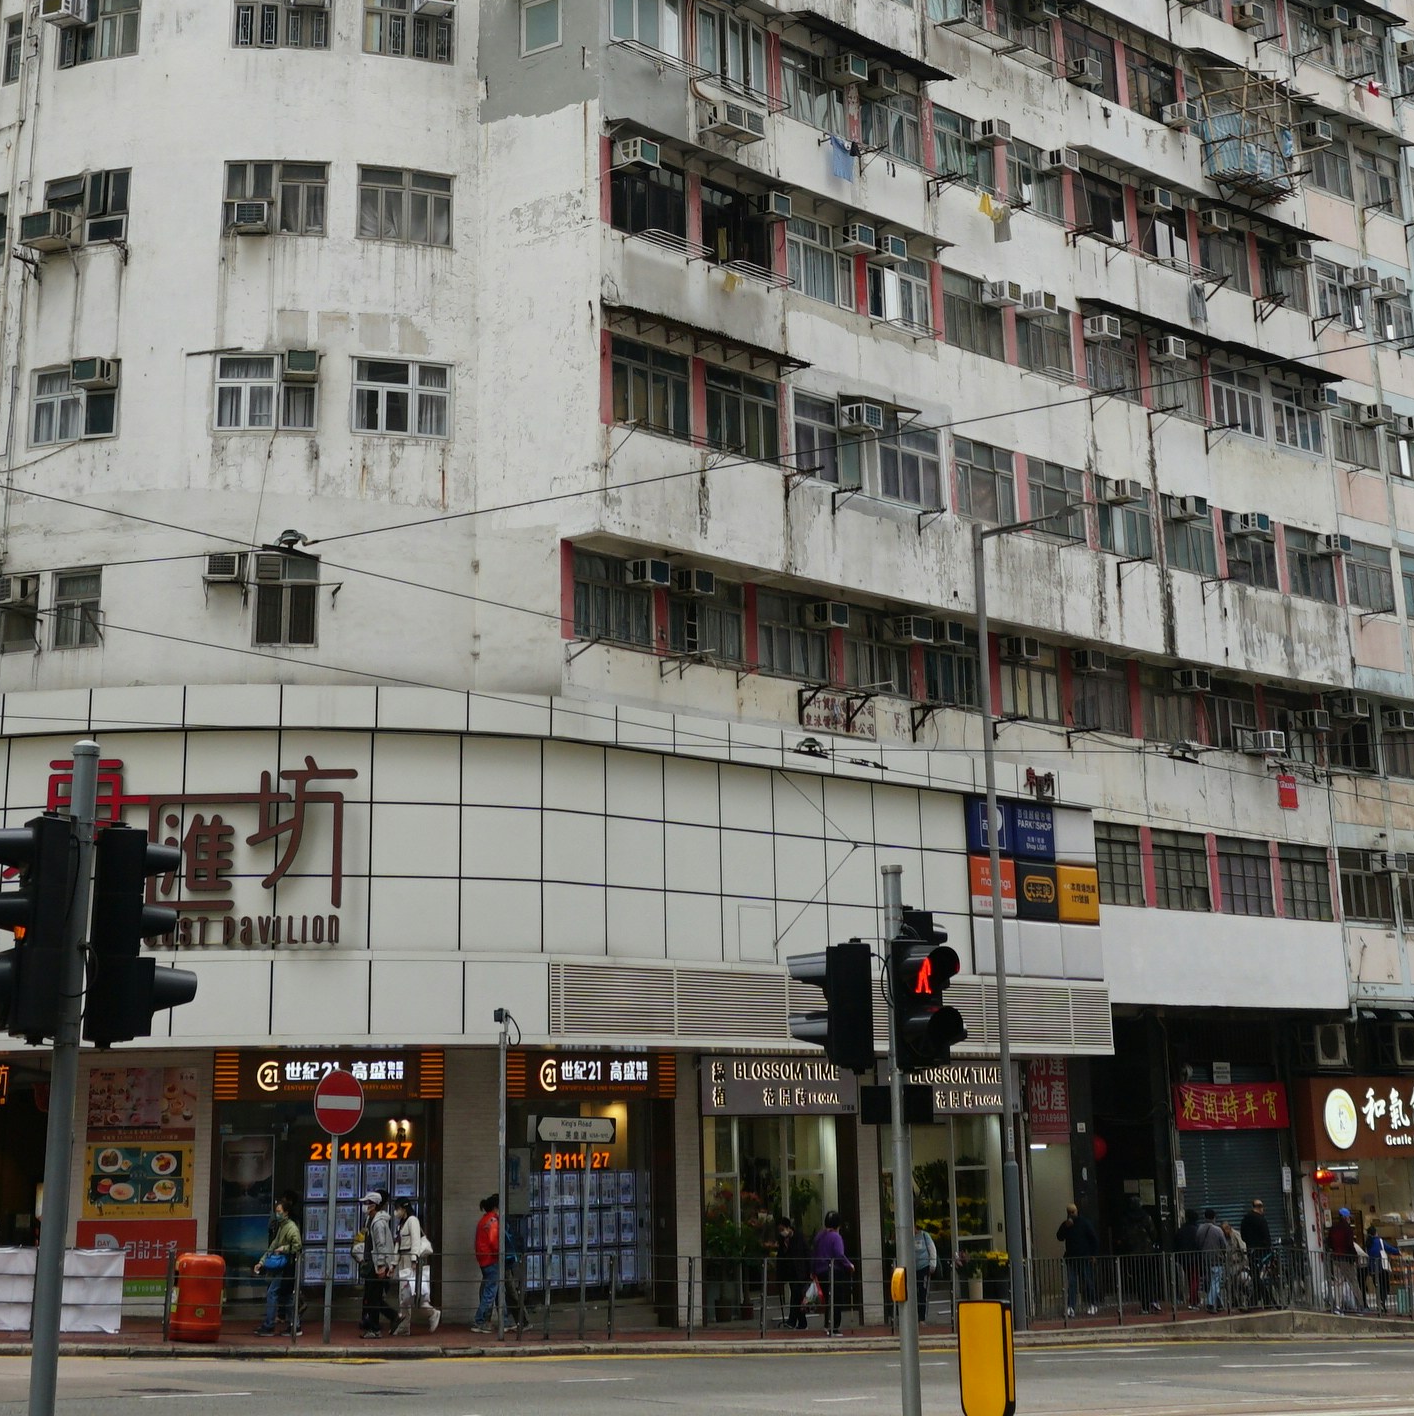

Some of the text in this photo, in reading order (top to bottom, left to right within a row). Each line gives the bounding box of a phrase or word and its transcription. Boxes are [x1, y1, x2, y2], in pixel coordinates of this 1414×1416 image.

[560, 1060, 602, 1081] 世紀21
[733, 1061, 840, 1081] BLOSSOM TIME
[971, 1067, 1003, 1084] TIME
[1031, 1080, 1067, 1111] 地產
[561, 1119, 593, 1130] King's Road
[1385, 1133, 1412, 1146] Gentle
[544, 1151, 610, 1170] 2811127
[97, 1239, 111, 1248] DAY
